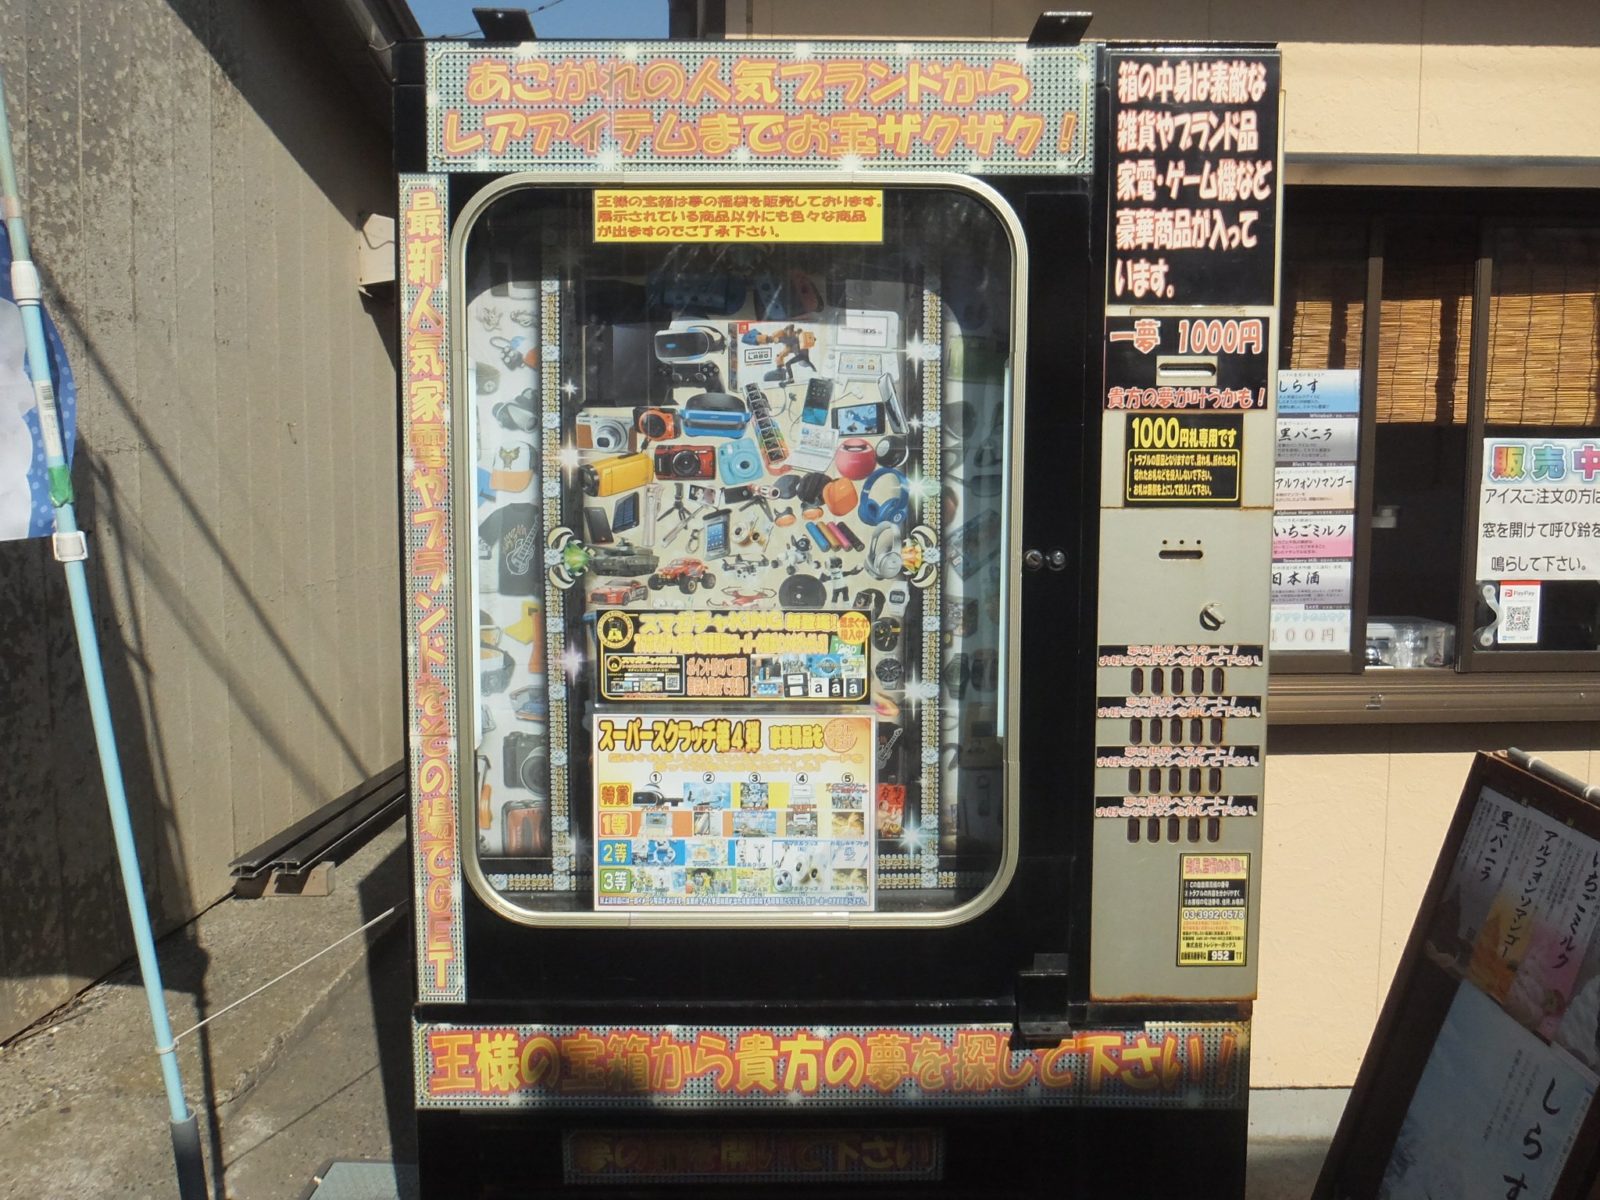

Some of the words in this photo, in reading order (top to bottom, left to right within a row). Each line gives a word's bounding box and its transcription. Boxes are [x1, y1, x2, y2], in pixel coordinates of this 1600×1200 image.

[467, 60, 1032, 104] あこがれの人気ブランドから
[1117, 60, 1267, 104] 箱の中身は素敵な
[1117, 109, 1259, 152] 雑貨やブランド品
[1116, 158, 1272, 202] 家電・ゲーム機など
[597, 195, 882, 208] 王様の宝箱は夢の福袋を販売しております。
[597, 209, 867, 223] 展示されている商品以外にも色々な商品
[597, 225, 780, 238] が出ますのでご了承下さい。
[1115, 207, 1259, 251] 豪華商品が入って
[1114, 257, 1175, 298] います。
[1110, 319, 1161, 354] 一夢
[1178, 319, 1263, 354] 1000円
[1279, 378, 1319, 393] しらす
[1132, 417, 1237, 449] 1000円札専用です
[1278, 427, 1333, 442] 黒バニラ
[1490, 444, 1600, 482] 販売中
[1274, 475, 1353, 489] アルフォンソマンゴー
[1273, 523, 1347, 538] いちごミルク
[1482, 522, 1600, 538] 窓を開けて呼び鈴を
[1491, 556, 1587, 572] 鳴らして下さい。
[1272, 570, 1320, 586] 日本酒
[405, 189, 457, 989] 最新人気家電やブランドをその場でGET
[602, 813, 628, 835] 1等
[603, 842, 628, 864] 2等
[603, 870, 628, 891] 3等
[1211, 950, 1230, 960] 952
